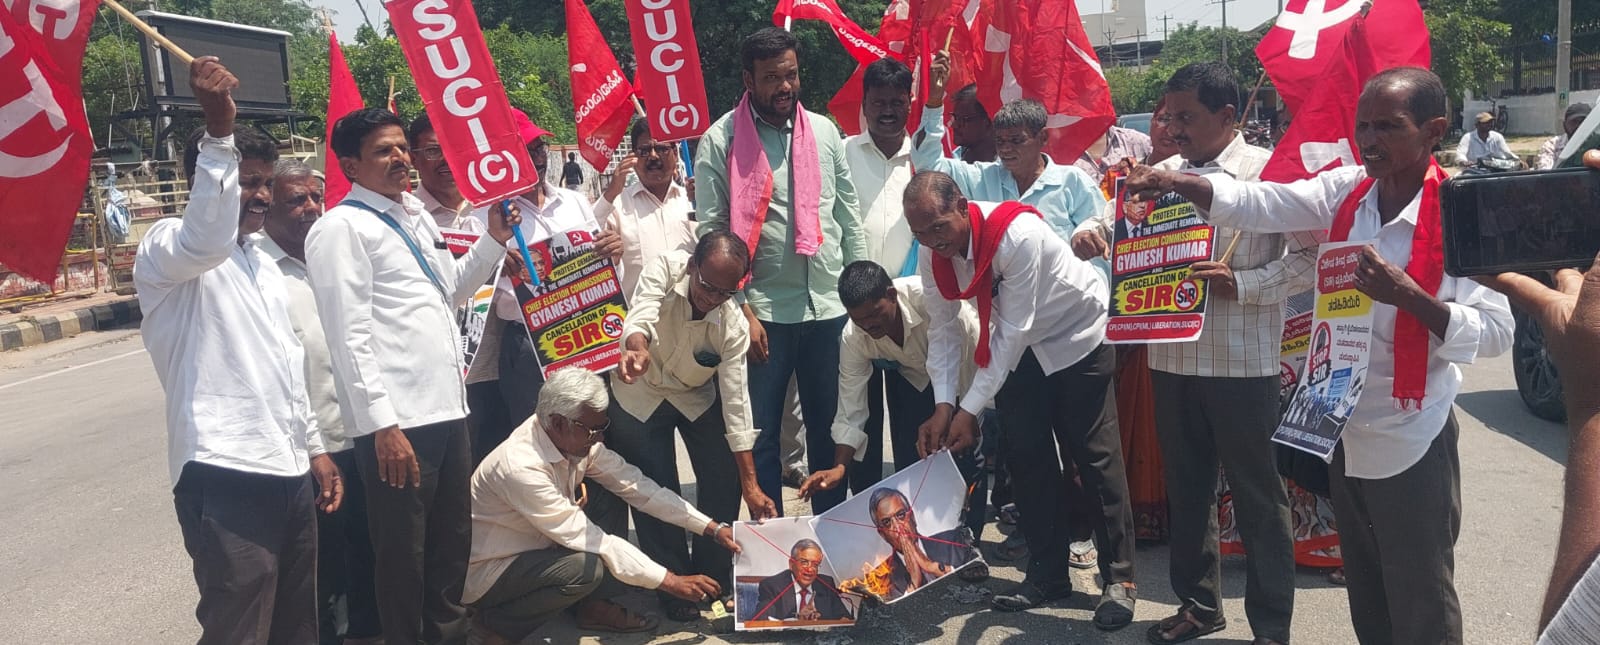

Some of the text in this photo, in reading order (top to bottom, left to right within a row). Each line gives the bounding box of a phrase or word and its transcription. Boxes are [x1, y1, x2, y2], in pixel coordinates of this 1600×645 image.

[1143, 226, 1152, 236] THE
[1152, 220, 1178, 234] IMMEDIATE
[1152, 209, 1177, 222] PROTEST
[1117, 228, 1210, 254] CHIEF ELECTION COMMISSIONER
[1116, 240, 1208, 272] GYANESH KUMAR
[553, 261, 577, 279] PROTEST
[557, 270, 582, 288] IMMEDIATE
[582, 261, 603, 276] REMOVAL
[1123, 270, 1187, 291] CANCELLATION OF
[525, 269, 613, 314] CHIEF ELECTION COMMISSIONER
[530, 279, 617, 327] GYANESH KUMAR
[1124, 284, 1174, 312] SIR
[545, 306, 608, 341] CANCELLATION OF
[571, 311, 583, 319] AND
[553, 322, 602, 357] SIR
[1312, 347, 1329, 369] STOP
[1311, 362, 1327, 385] SIR
